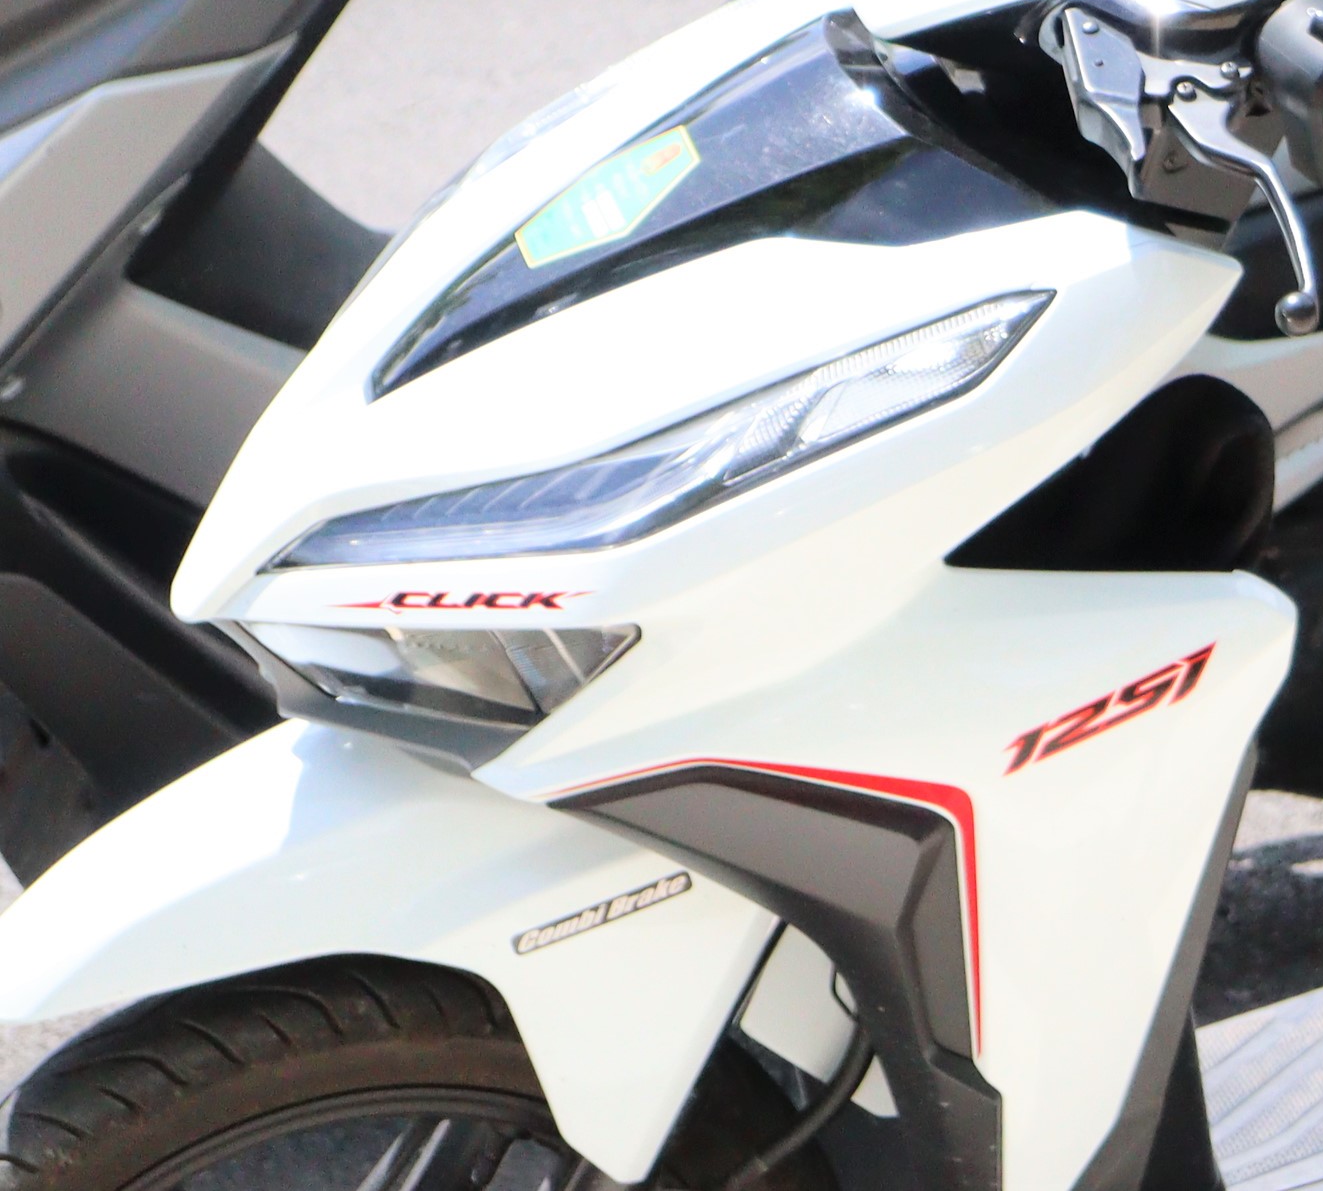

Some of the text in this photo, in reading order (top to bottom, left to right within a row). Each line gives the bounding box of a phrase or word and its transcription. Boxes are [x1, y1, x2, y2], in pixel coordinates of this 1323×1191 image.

[381, 590, 567, 615] CLICK
[515, 872, 691, 955] Combi Brake
